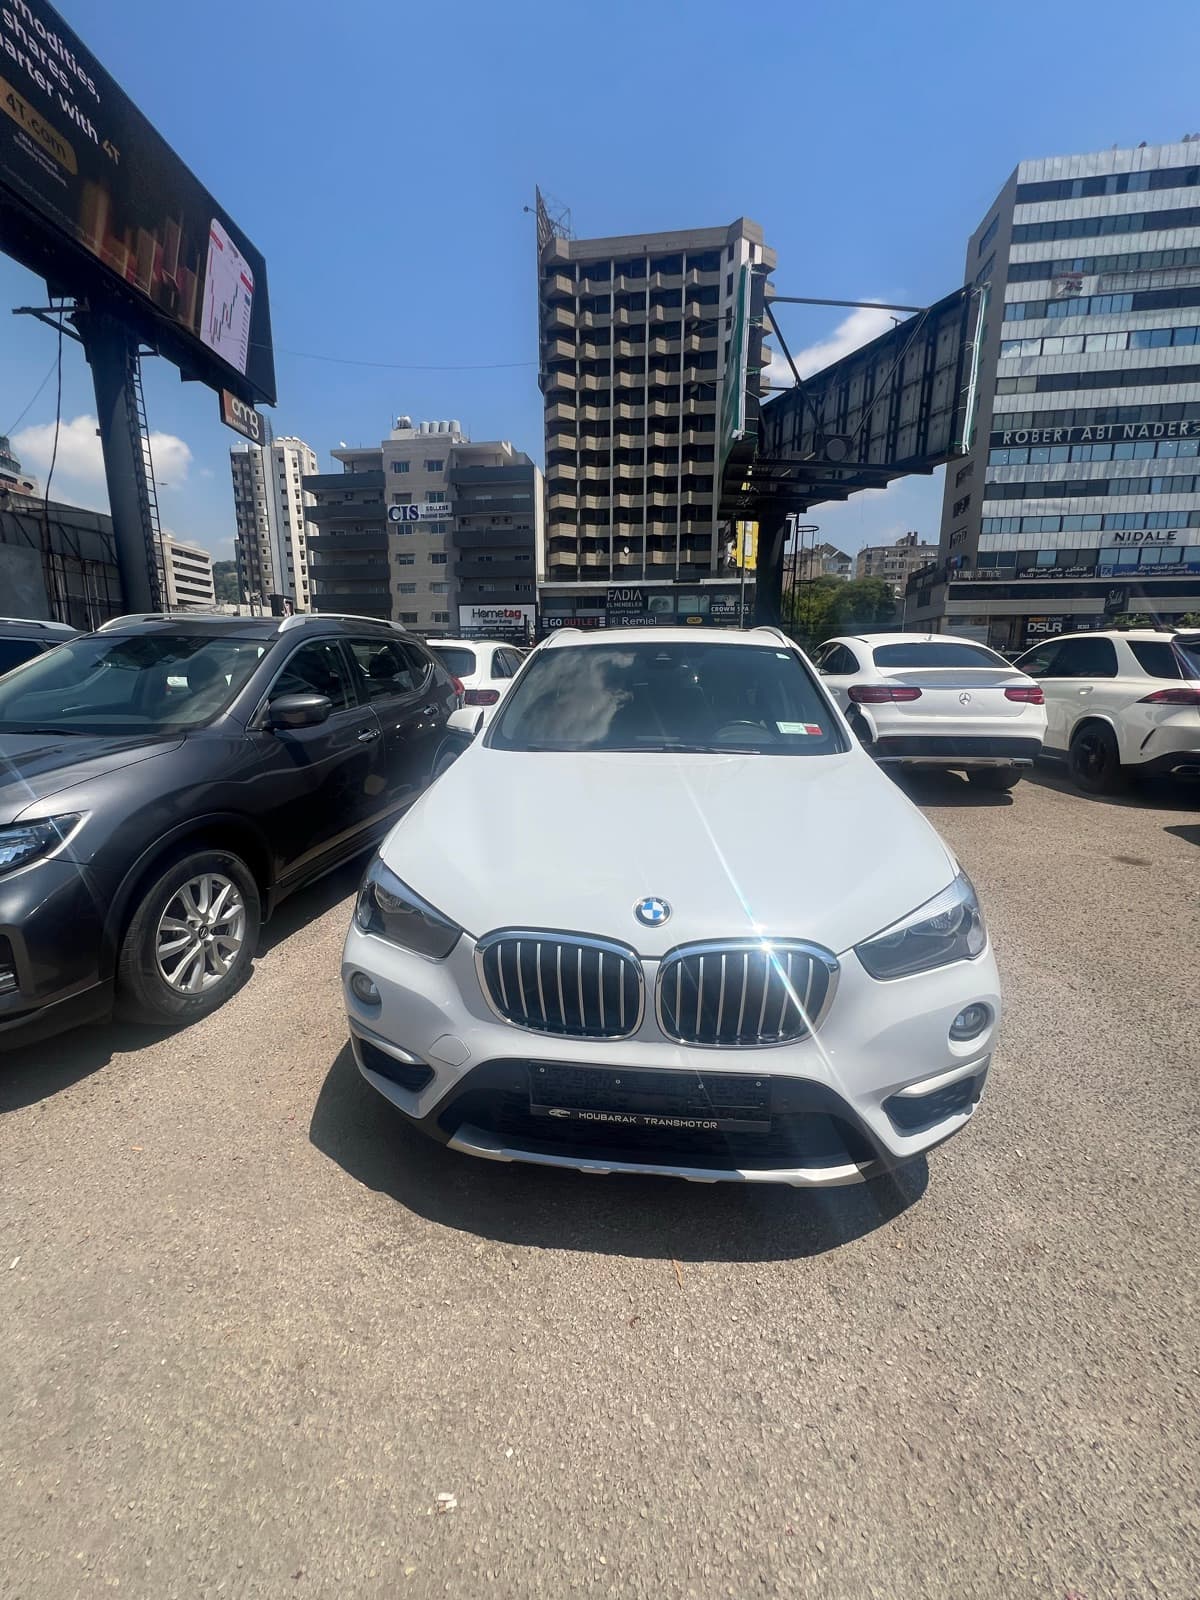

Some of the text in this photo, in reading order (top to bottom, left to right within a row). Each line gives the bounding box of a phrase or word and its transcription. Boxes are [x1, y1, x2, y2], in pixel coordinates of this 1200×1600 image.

[3, 8, 74, 95] shares.
[9, 0, 101, 103] modities,
[6, 92, 68, 160] 4T.com
[58, 92, 99, 144] with
[102, 139, 120, 165] 4T
[1003, 422, 1189, 445] ROBERT ABI NADER
[388, 504, 419, 521] CIS
[1114, 531, 1178, 542] NIDALE
[607, 589, 642, 601] FADIA
[472, 608, 522, 619] Hometag
[550, 617, 599, 627] GO OUTLET
[622, 616, 657, 625] Remiel
[1027, 622, 1063, 633] DSLR
[578, 1112, 719, 1129] MOUBARAK TRANSMOTOR
